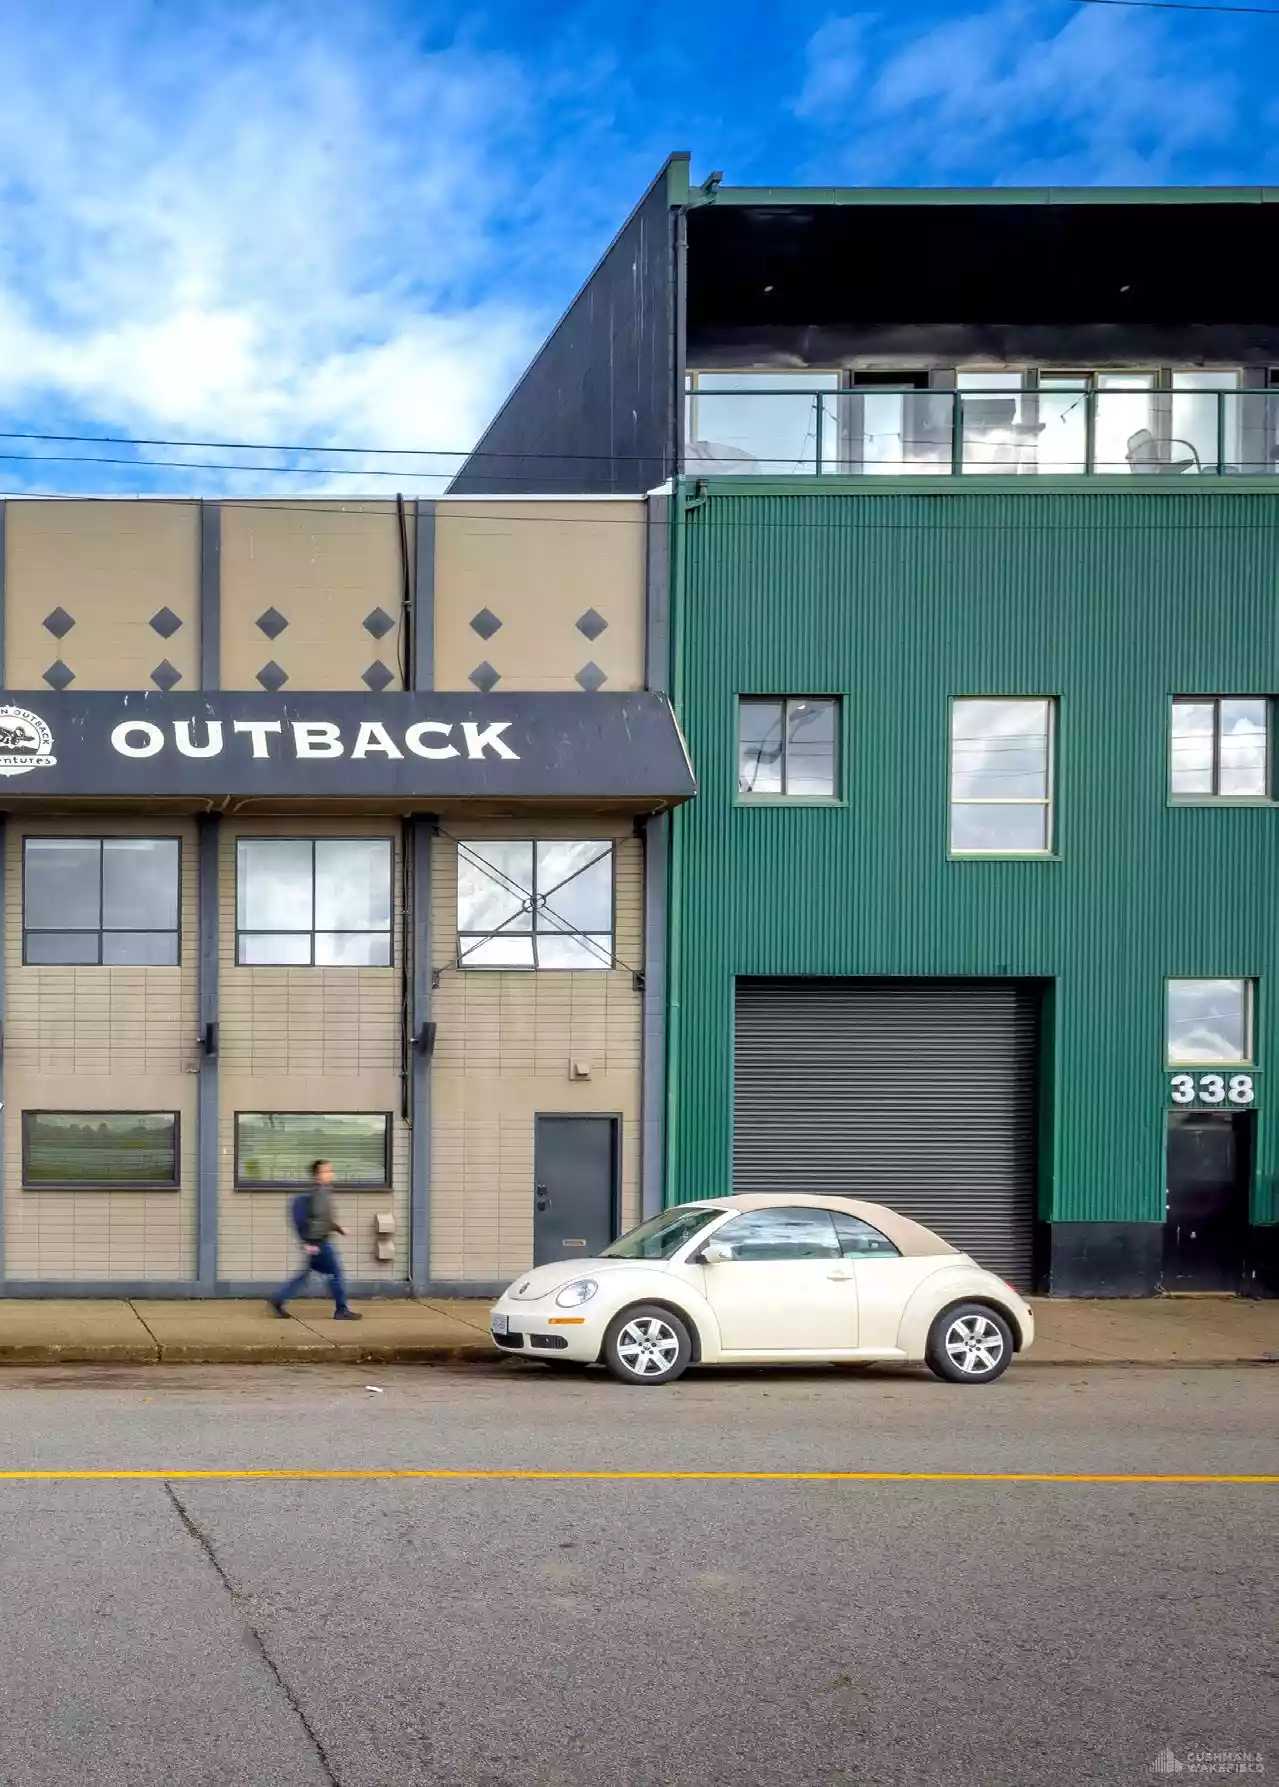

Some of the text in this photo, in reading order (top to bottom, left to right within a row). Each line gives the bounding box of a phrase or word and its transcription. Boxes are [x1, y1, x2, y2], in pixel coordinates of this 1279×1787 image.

[13, 709, 50, 745] OUTBACK
[110, 720, 521, 760] OUTBACK
[1170, 1074, 1255, 1104] 338
